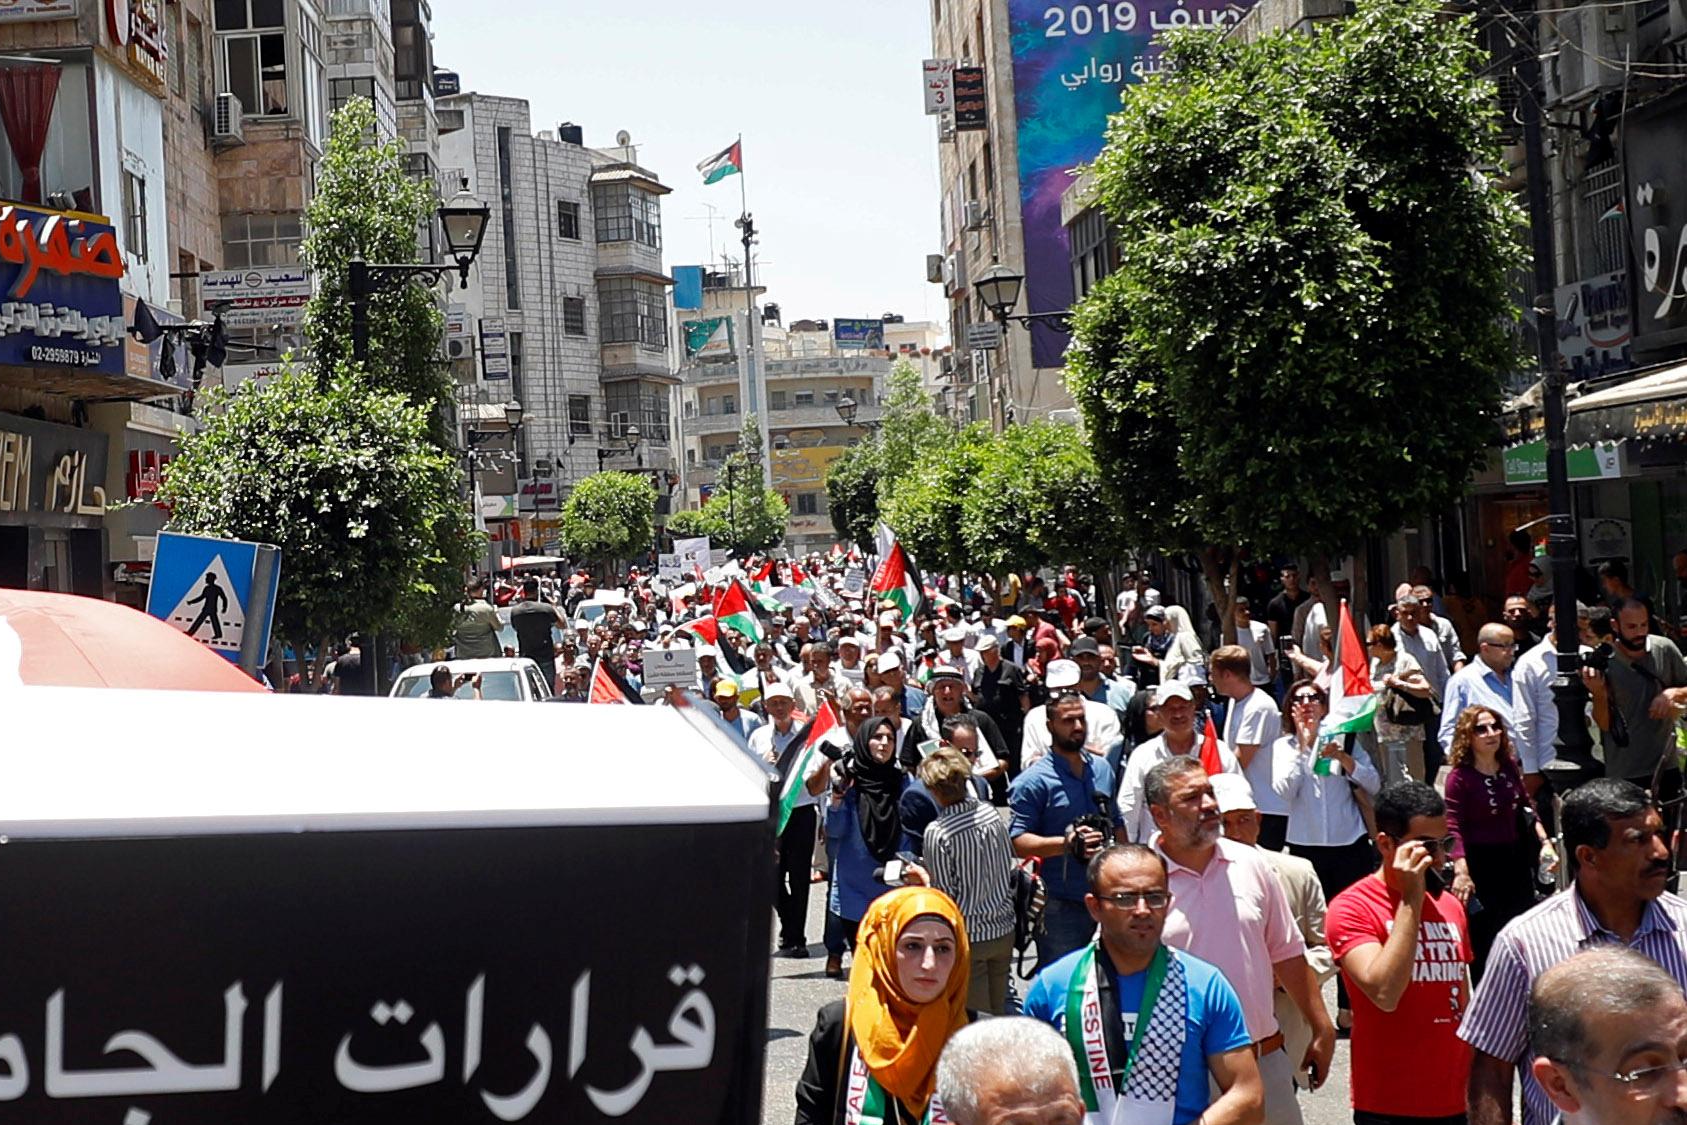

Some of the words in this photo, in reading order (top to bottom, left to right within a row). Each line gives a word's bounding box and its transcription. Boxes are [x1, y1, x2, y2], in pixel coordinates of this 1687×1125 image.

[1044, 2, 1136, 37] 2019
[1061, 57, 1122, 91] روابي
[936, 91, 945, 104] 3
[265, 270, 309, 286] السعيد
[50, 450, 105, 516] حازم
[1423, 921, 1462, 942] RICH
[1425, 942, 1458, 961] TRY
[334, 963, 716, 1122] قرارات
